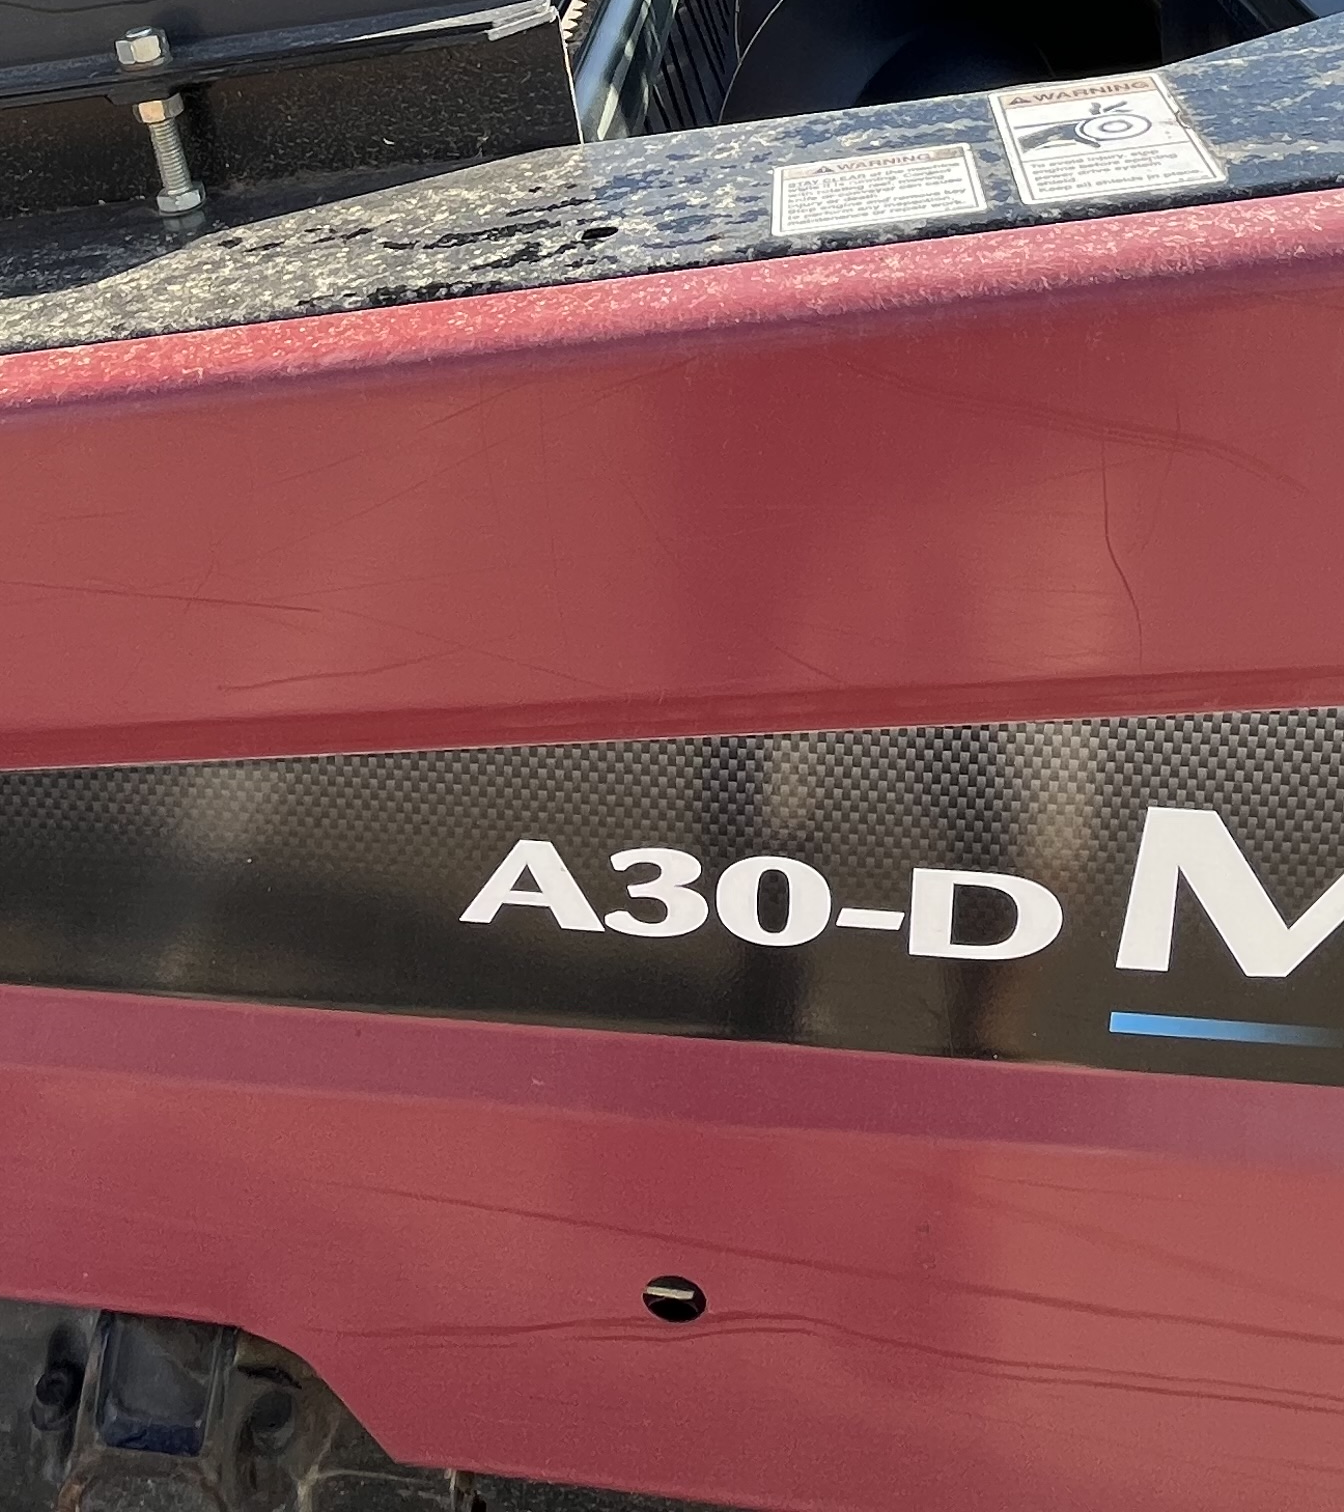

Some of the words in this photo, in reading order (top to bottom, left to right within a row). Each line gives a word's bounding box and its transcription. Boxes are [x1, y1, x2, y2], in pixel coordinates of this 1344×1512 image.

[1032, 80, 1149, 102] WARNING
[837, 152, 930, 170] WARNING
[788, 179, 818, 188] STAY
[822, 173, 865, 183] CLEAR
[459, 840, 1062, 959] A30-D
